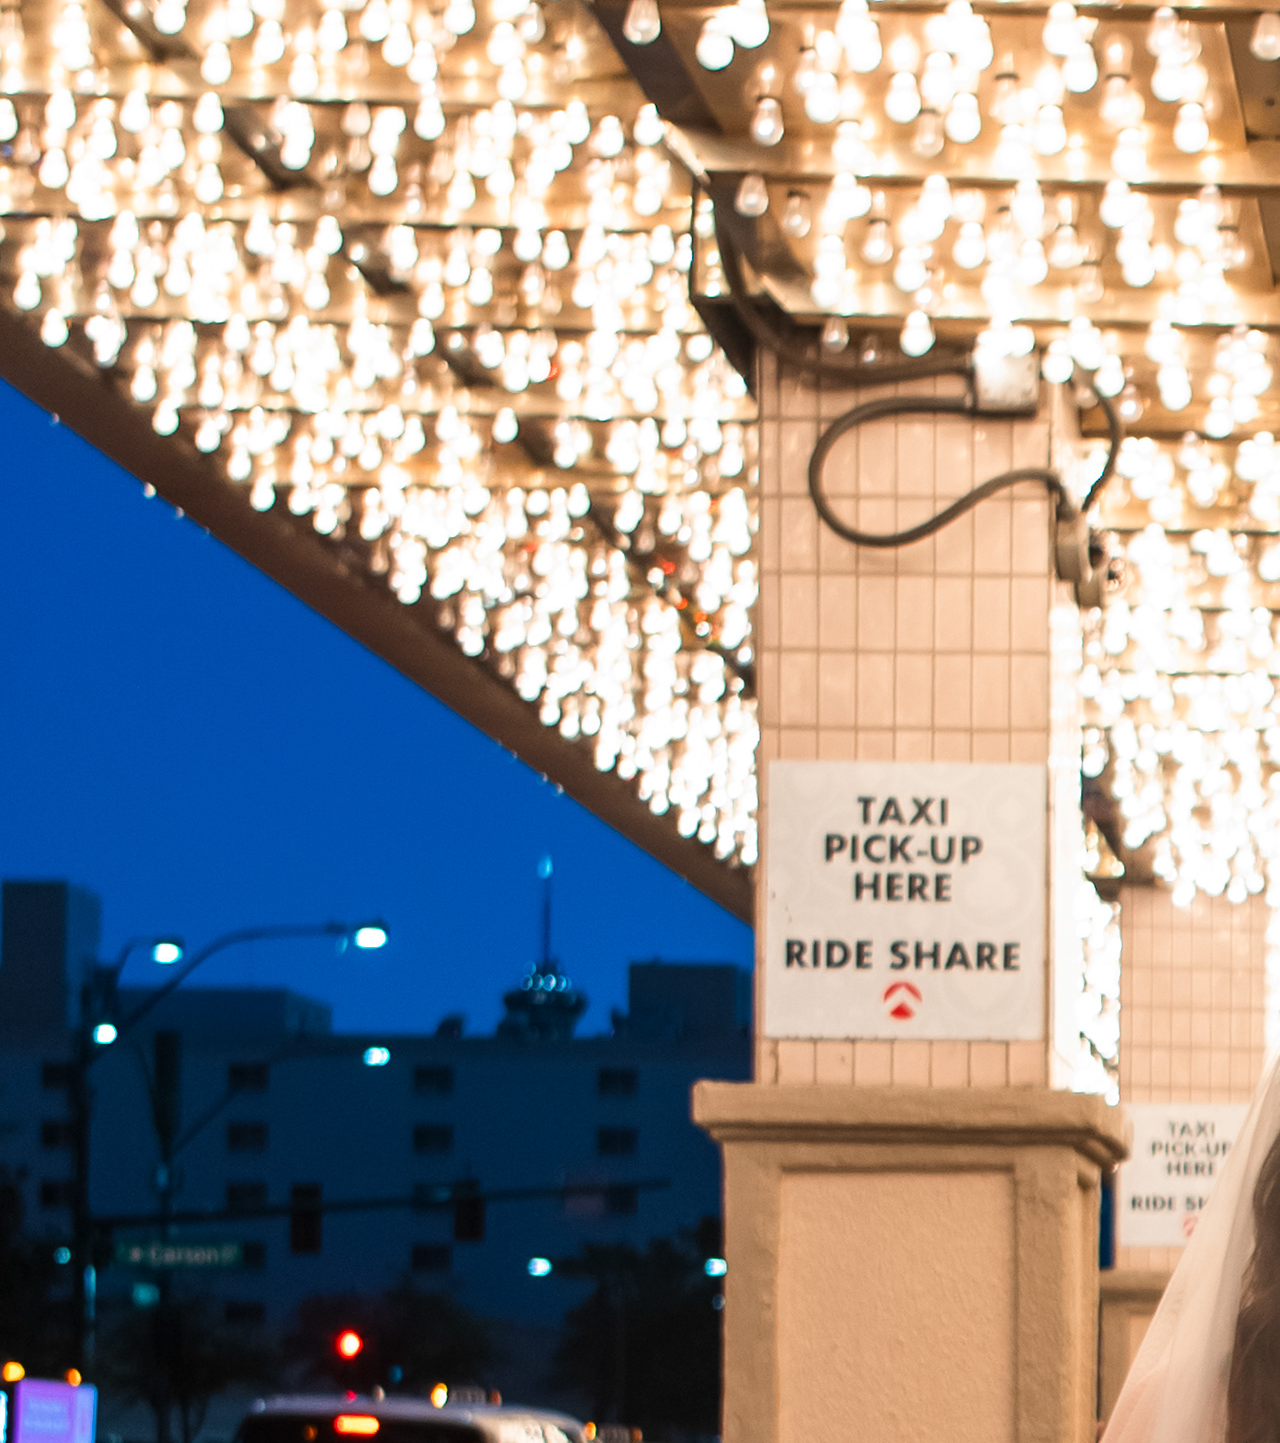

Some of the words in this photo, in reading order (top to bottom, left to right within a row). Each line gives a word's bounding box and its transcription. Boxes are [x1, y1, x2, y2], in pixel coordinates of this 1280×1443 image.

[857, 796, 949, 826] TAXI
[824, 833, 984, 865] PICK-UP
[854, 871, 952, 902] HERE
[786, 939, 873, 970] RIDE
[890, 940, 1021, 971] SHARE
[1168, 1120, 1216, 1139] TAXI
[1131, 1195, 1177, 1212] RIDE
